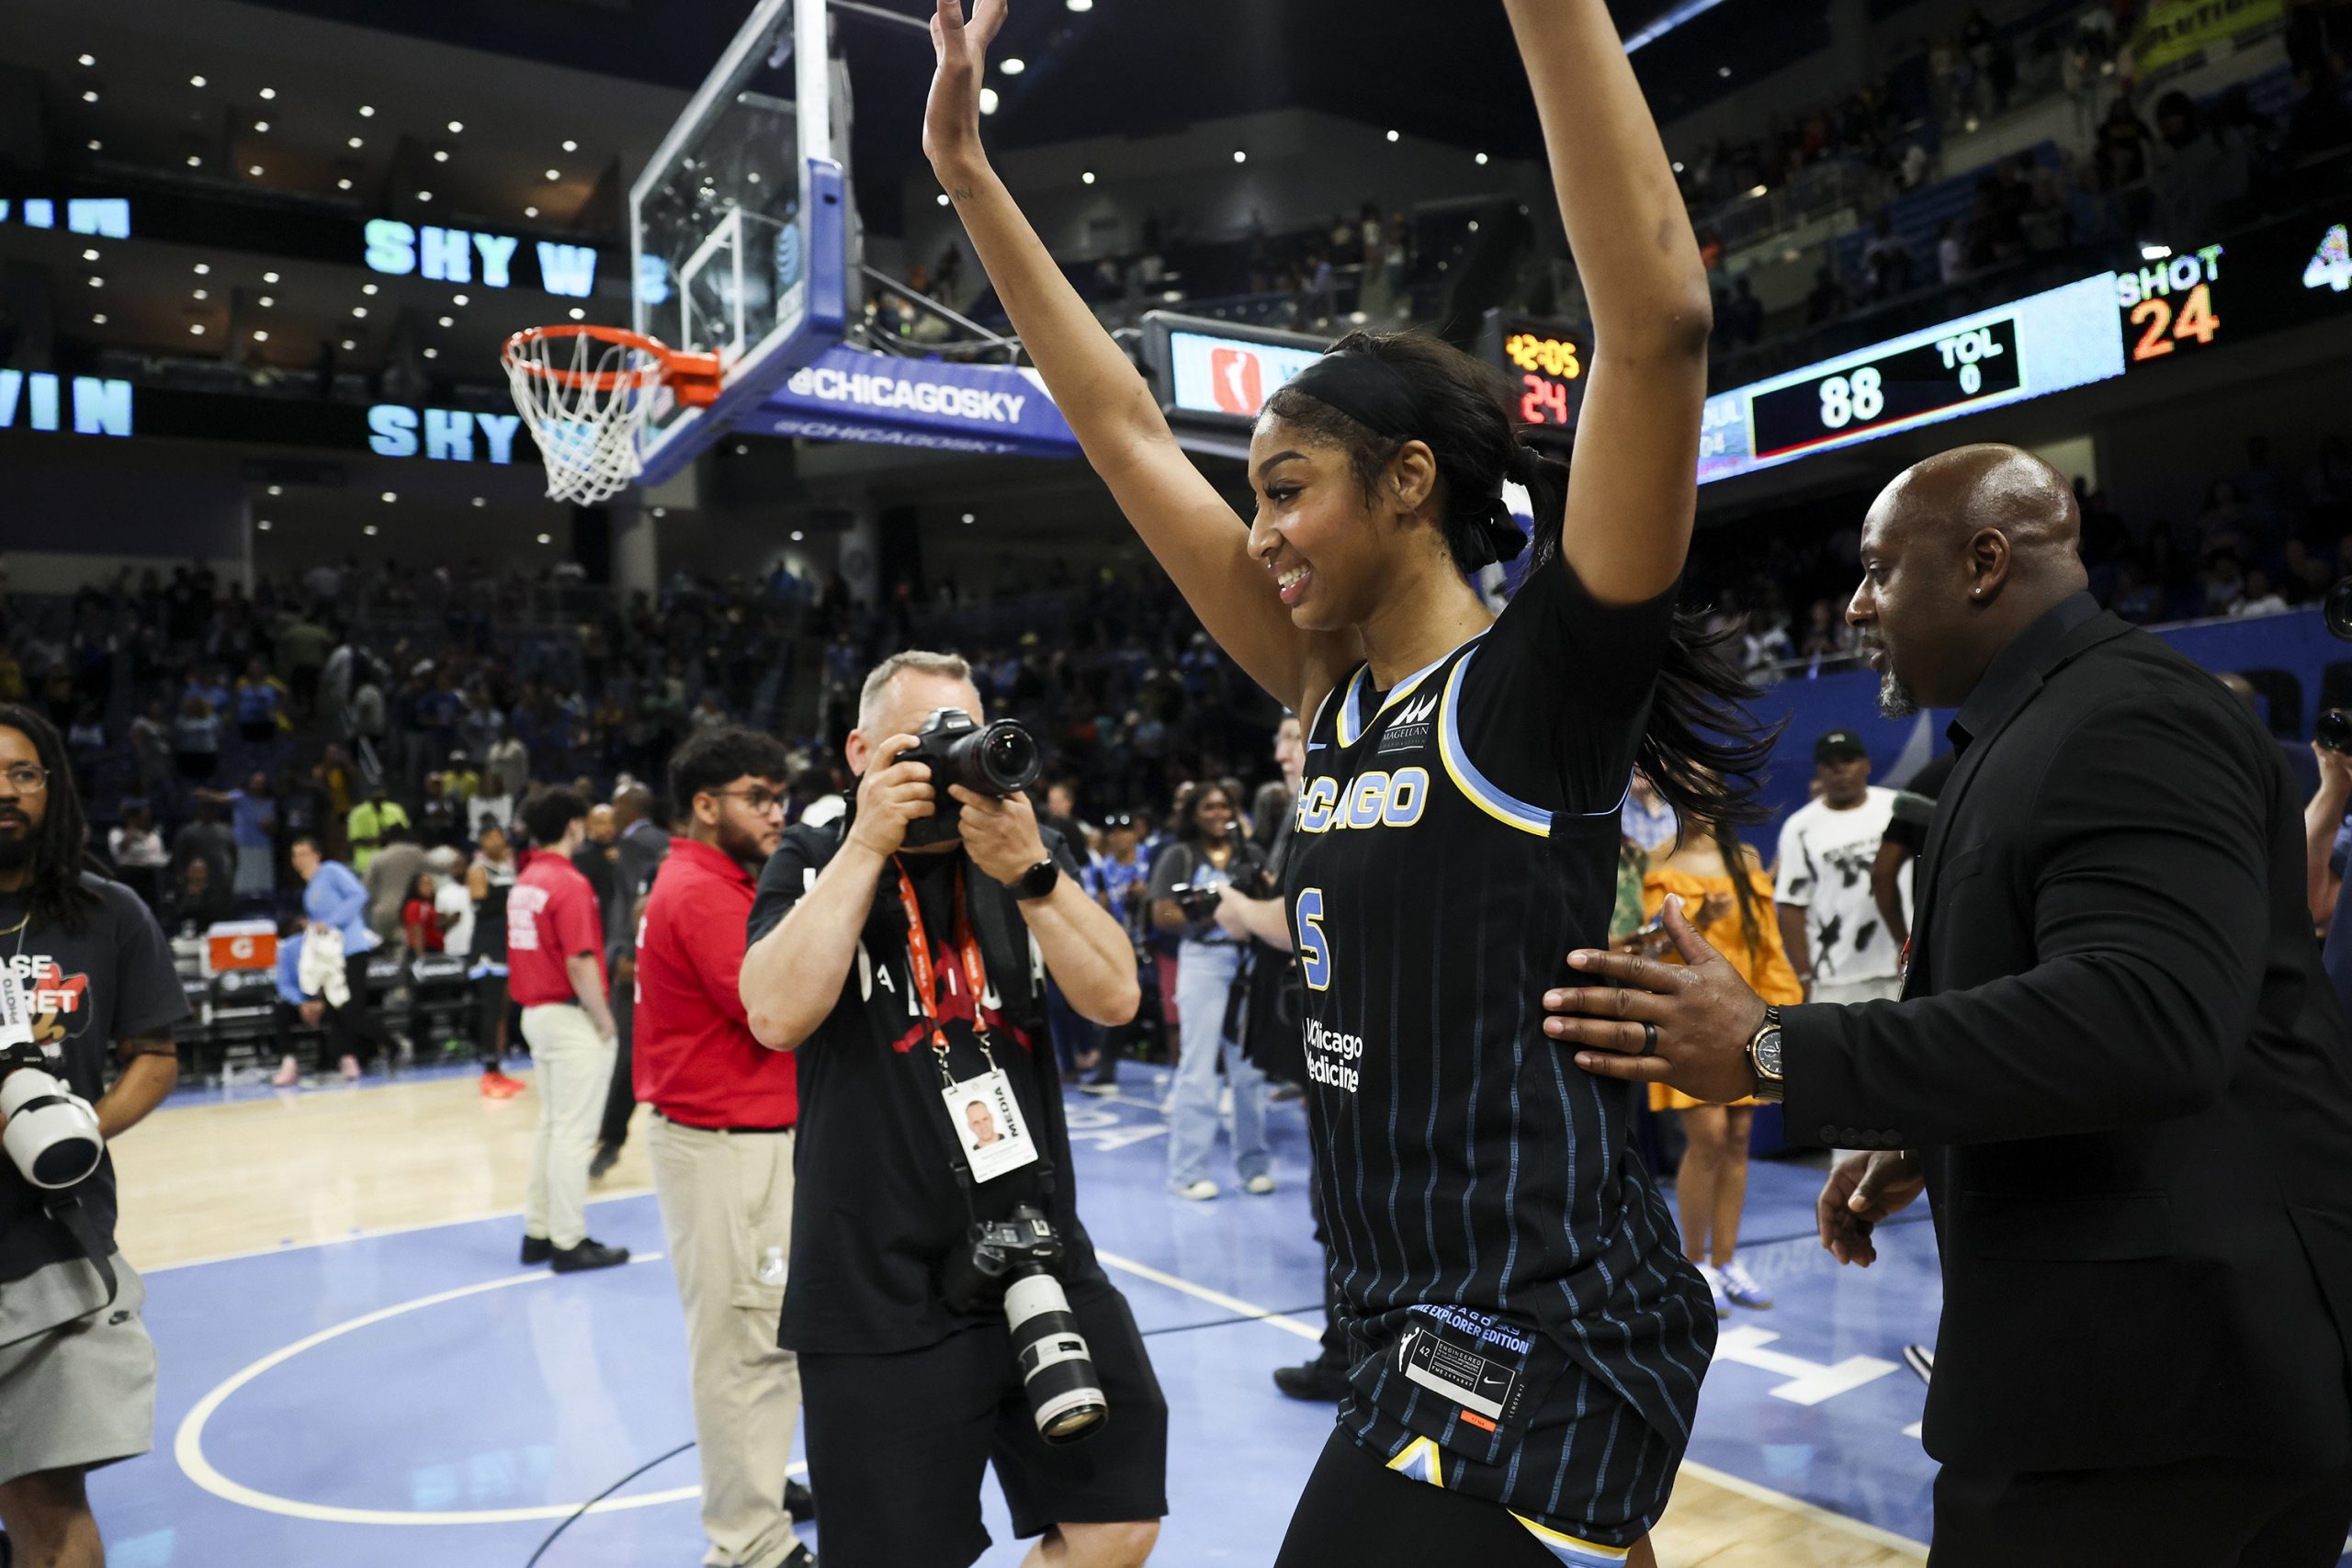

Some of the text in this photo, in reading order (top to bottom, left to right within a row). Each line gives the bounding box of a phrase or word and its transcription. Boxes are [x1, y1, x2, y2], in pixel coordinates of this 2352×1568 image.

[2117, 243, 2224, 307] SHOT
[2131, 284, 2220, 361] 24
[1936, 328, 2004, 369] TOL
[787, 367, 1024, 423] @CHICAGOSKY
[1521, 374, 1567, 424] 24
[1819, 367, 1883, 428] 88
[1383, 726, 1430, 741] MAGELLAN
[1296, 887, 1331, 991] 5
[0, 954, 52, 979] SE
[3, 977, 19, 1025] PHOTO
[994, 1087, 1019, 1137] MEDIA
[1419, 1346, 1430, 1358] 42
[1429, 1305, 1480, 1337] EXPLORER
[1482, 1328, 1530, 1355] EDITION
[1439, 1343, 1482, 1366] ENGINEERED
